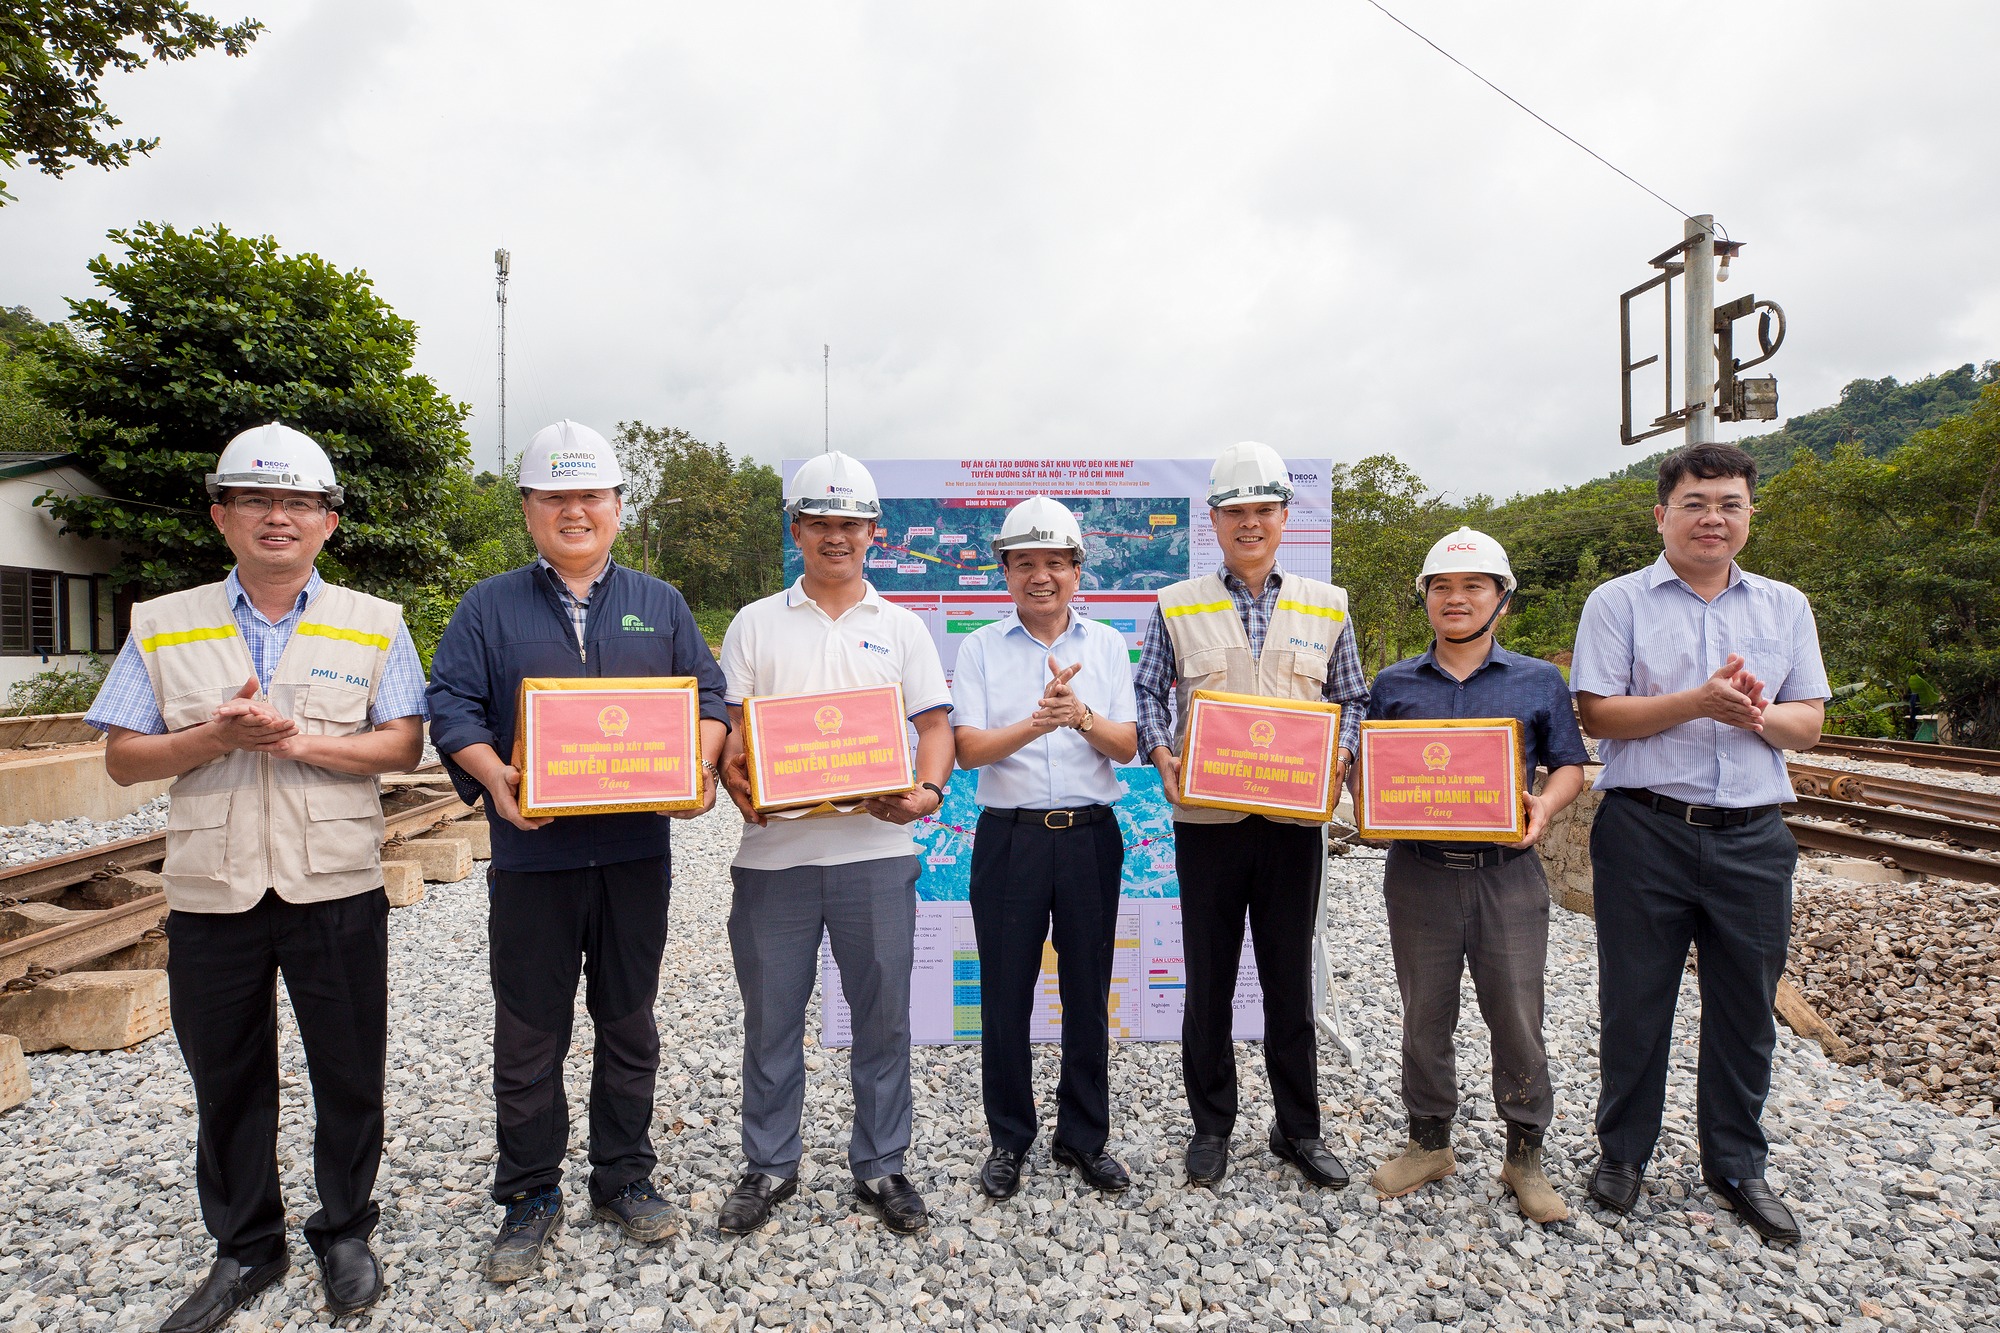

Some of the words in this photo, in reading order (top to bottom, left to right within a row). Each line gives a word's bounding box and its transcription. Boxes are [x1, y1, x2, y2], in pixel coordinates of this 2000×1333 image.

[552, 470, 578, 478] DMEC
[1447, 542, 1477, 552] RCC
[1290, 638, 1308, 647] PMU
[311, 668, 338, 679] PMU
[346, 674, 369, 688] RAIL
[561, 743, 578, 753] THỨ
[614, 742, 624, 753] BỘ
[626, 741, 641, 752] XÂY
[644, 741, 666, 752] DỰNG
[784, 744, 799, 754] THỨ
[831, 738, 841, 749] BỘ
[843, 737, 857, 747] XÂY
[859, 735, 878, 746] DỰNG
[774, 752, 827, 775] NGUYỄN
[830, 751, 867, 769] DANH
[870, 748, 894, 763] HUY
[1216, 747, 1230, 757] THỨ
[1259, 752, 1268, 762] BỘ
[1270, 754, 1283, 763] XÂY
[1284, 755, 1304, 766] DỰNG
[548, 754, 607, 776] NGUYỄN
[611, 757, 650, 774] DANH
[653, 756, 680, 772] HUY
[821, 772, 850, 784] Tặng
[1204, 760, 1252, 778] NGUYỄN
[1255, 766, 1289, 782] DANH
[1292, 770, 1316, 785] HUY
[598, 777, 631, 790] Tặng
[1391, 775, 1405, 784] THỨ
[1437, 775, 1446, 785] BỘ
[1448, 775, 1462, 784] XÂY
[1464, 776, 1485, 785] DỰNG
[1243, 780, 1270, 794] Tặng
[1380, 785, 1431, 803] NGUYỄN
[1435, 790, 1471, 803] DANH
[1474, 790, 1501, 804] HUY
[1424, 806, 1454, 818] Tặng
